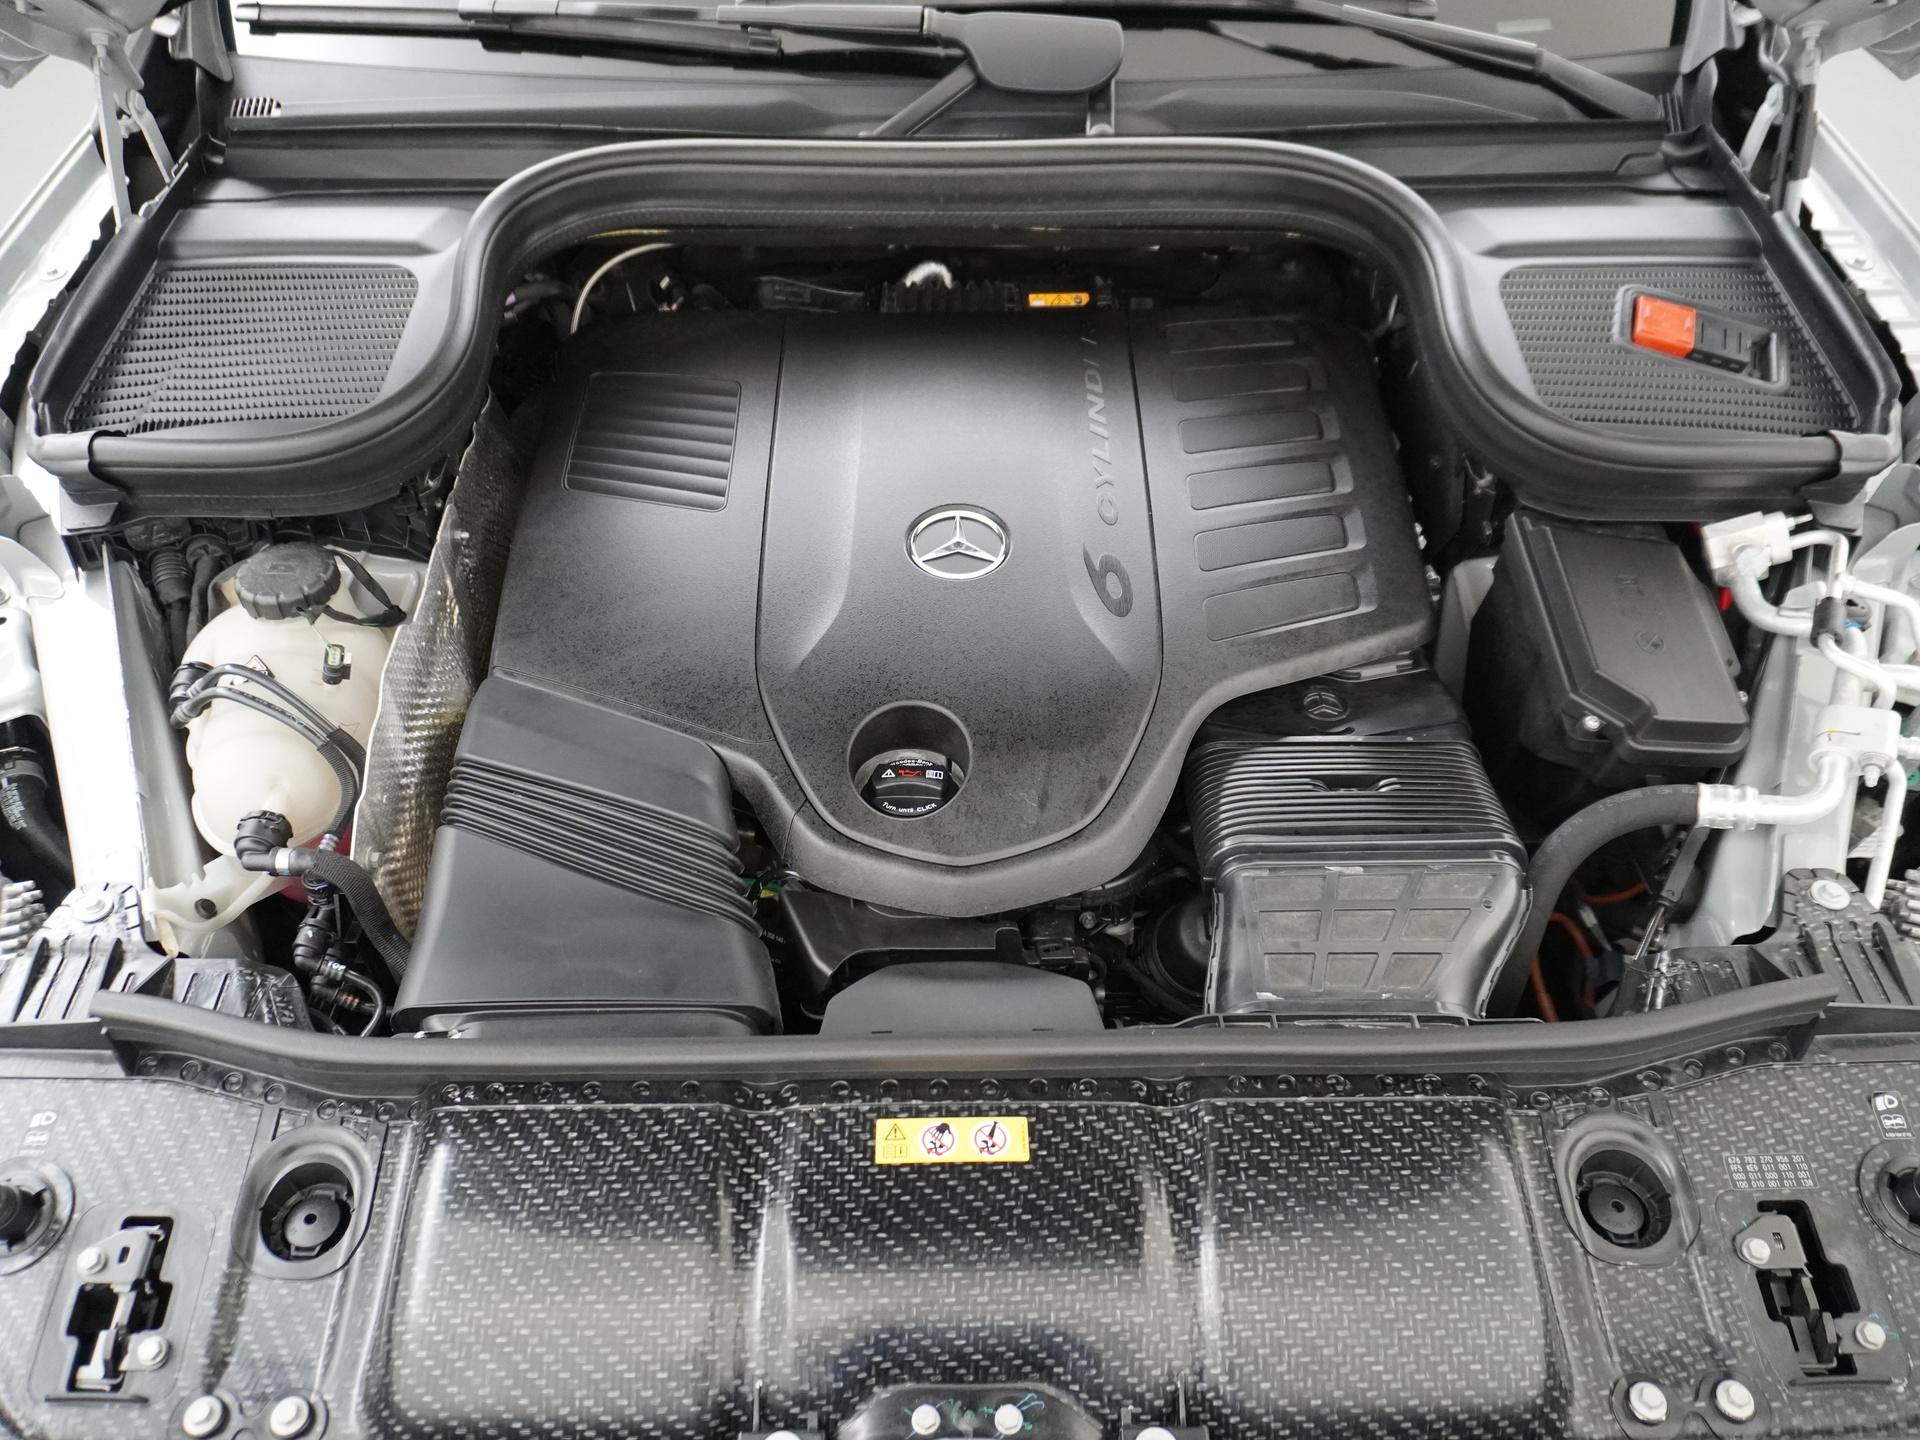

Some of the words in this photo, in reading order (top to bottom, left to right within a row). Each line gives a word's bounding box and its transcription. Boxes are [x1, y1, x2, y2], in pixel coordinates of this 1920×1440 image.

[1079, 325, 1118, 525] CYLIND
[1082, 543, 1133, 618] 6
[882, 801, 897, 812] Turn
[916, 802, 937, 813] CLICK
[327, 961, 346, 971] TOP
[1762, 1163, 1775, 1171] 011
[1778, 1163, 1791, 1171] 001
[1749, 1172, 1762, 1180] 011
[1782, 1171, 1794, 1179] 110
[1797, 1171, 1811, 1179] 001
[1736, 1180, 1749, 1188] 100
[1751, 1180, 1765, 1188] 010
[1768, 1180, 1781, 1188] 001
[1784, 1179, 1797, 1187] 011
